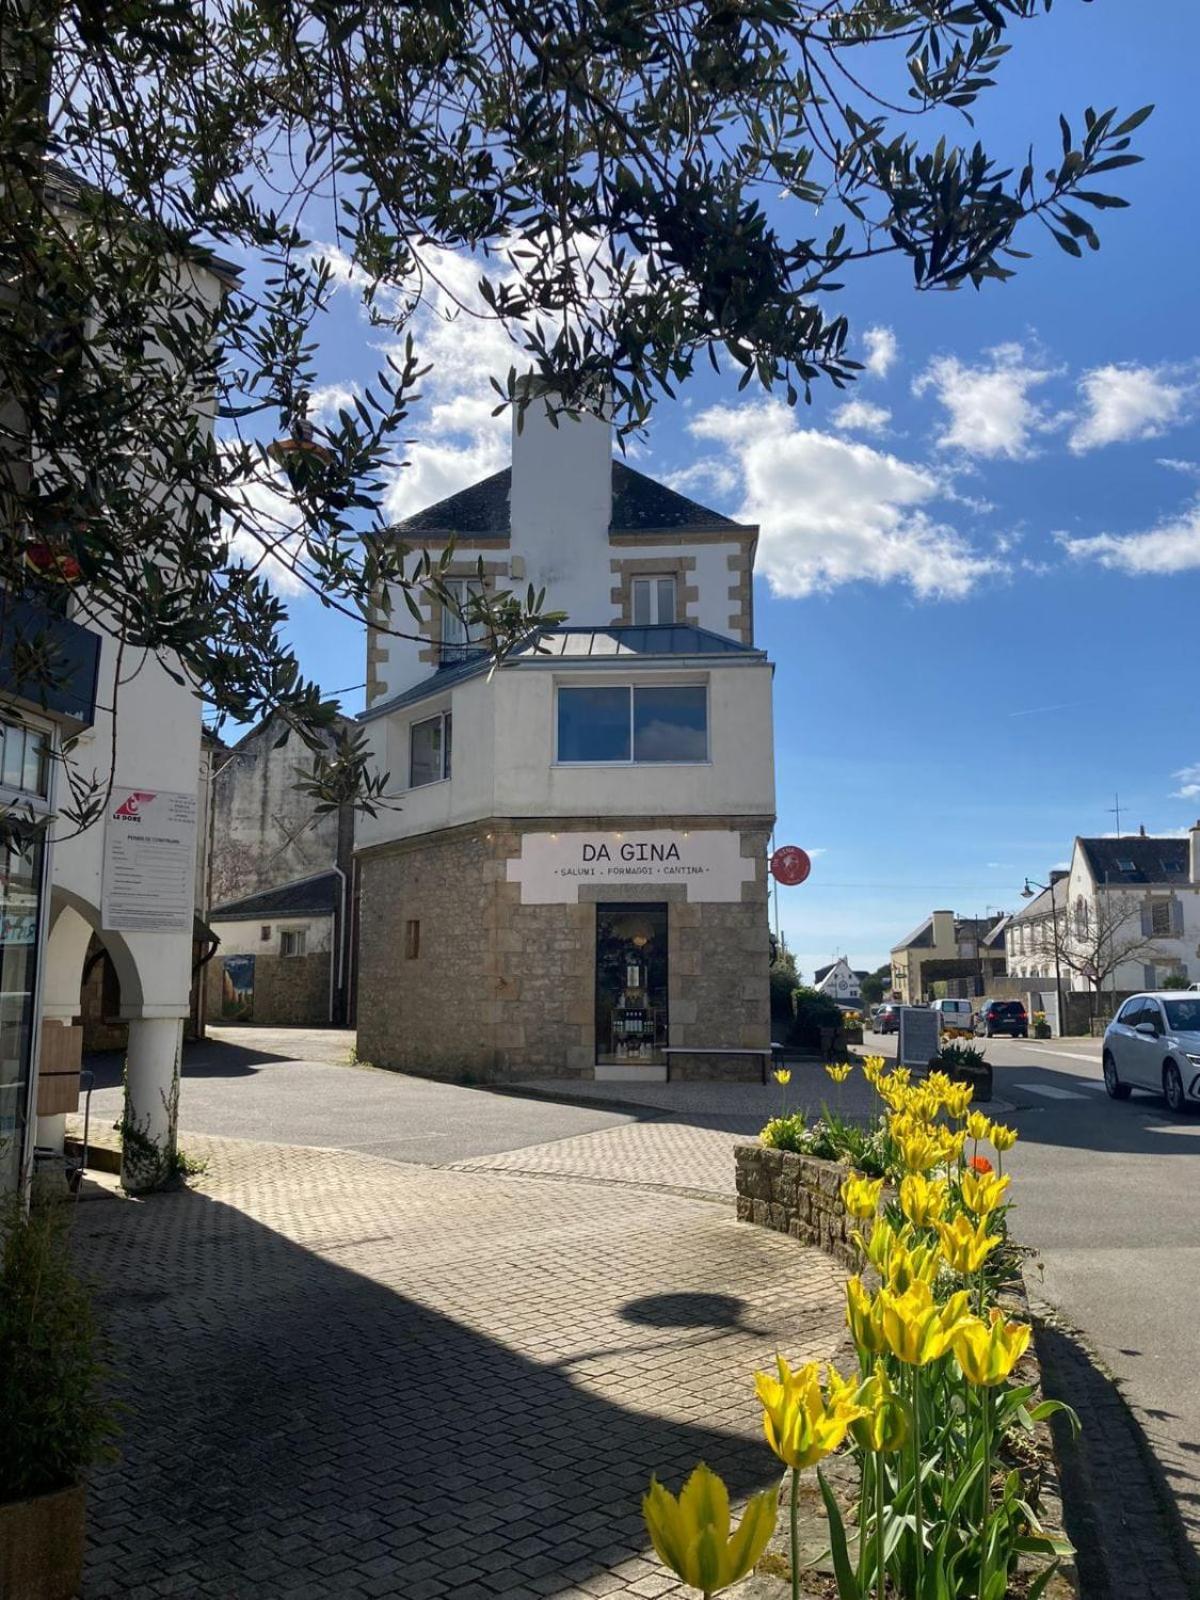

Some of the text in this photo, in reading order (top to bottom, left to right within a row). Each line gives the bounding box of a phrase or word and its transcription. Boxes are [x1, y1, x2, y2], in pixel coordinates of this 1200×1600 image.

[582, 843, 681, 862] DA GINA
[560, 866, 704, 877] SALUMI FORMAGGI CANTINA
